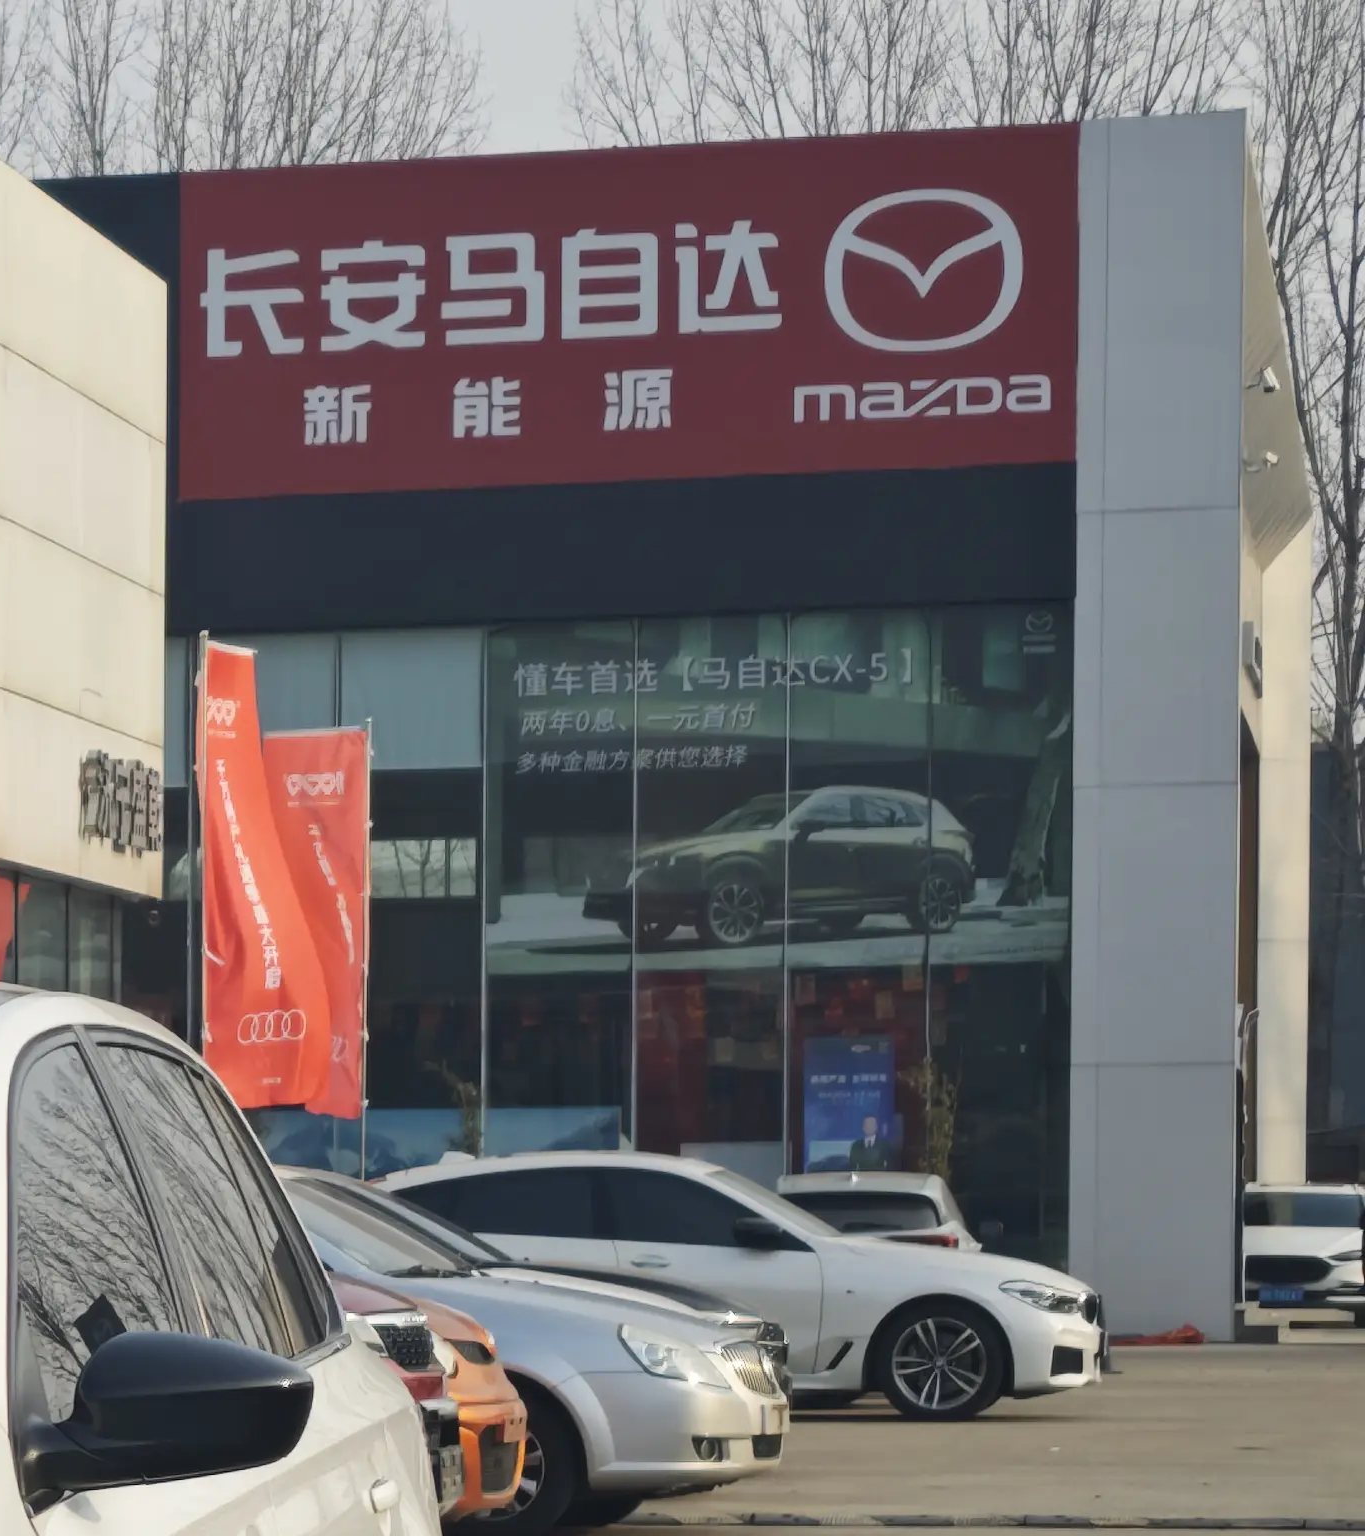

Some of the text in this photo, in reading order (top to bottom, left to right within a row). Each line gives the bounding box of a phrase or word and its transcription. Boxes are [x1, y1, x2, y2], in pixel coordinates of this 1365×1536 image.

[199, 219, 782, 358] 长安马自达
[302, 368, 673, 446] 新能源
